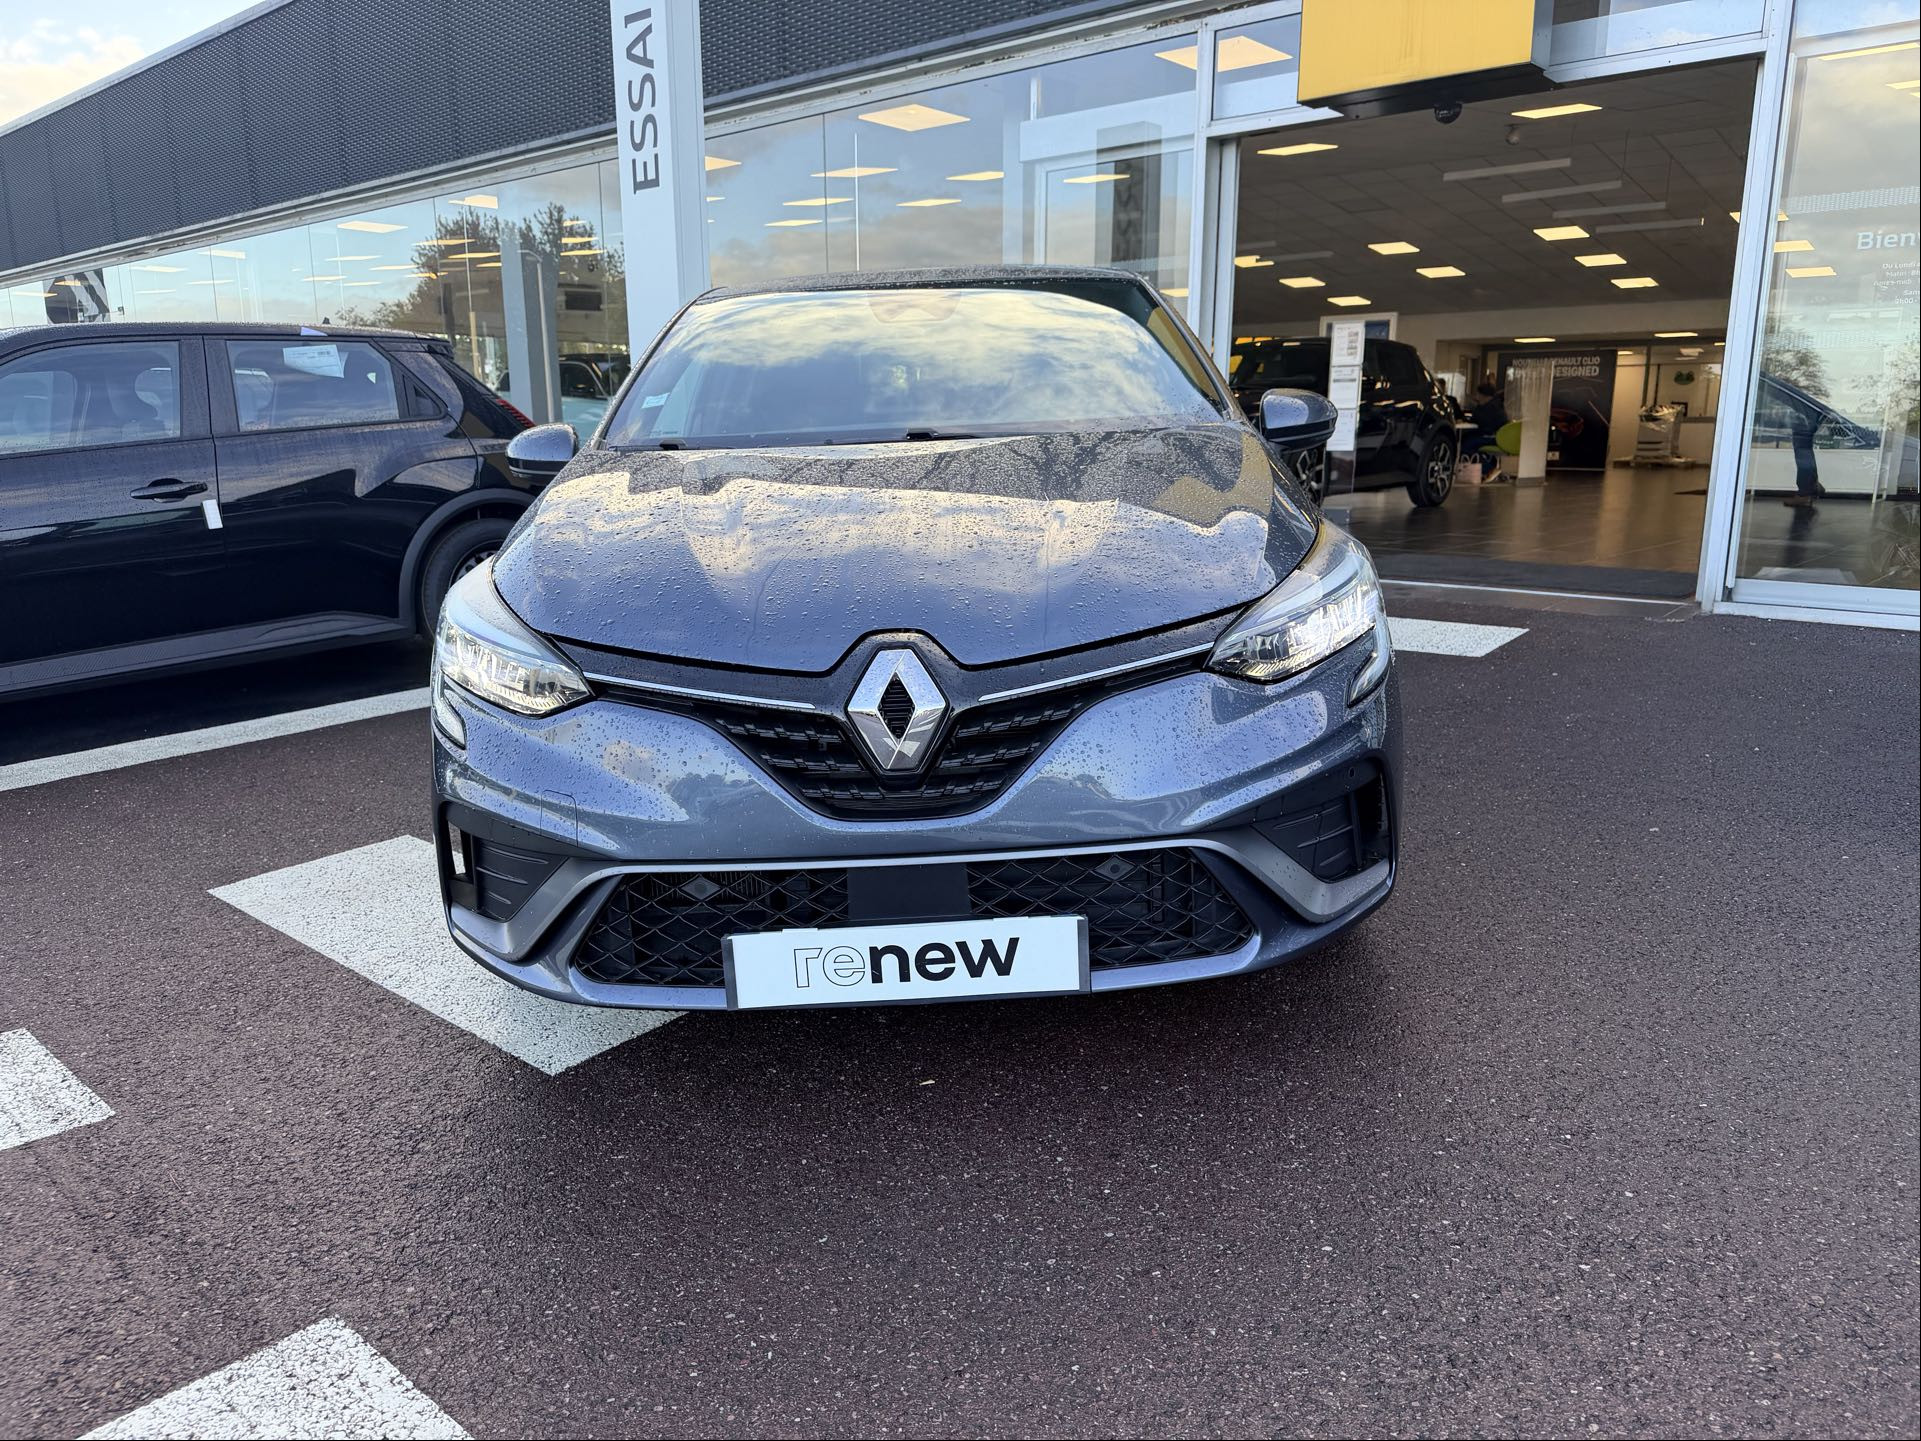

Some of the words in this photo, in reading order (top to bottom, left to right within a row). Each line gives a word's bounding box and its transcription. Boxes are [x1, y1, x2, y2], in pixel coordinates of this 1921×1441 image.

[624, 7, 660, 195] ESSAI
[1857, 229, 1920, 250] Bien
[1582, 356, 1600, 365] CLIO
[793, 937, 1020, 988] renew
